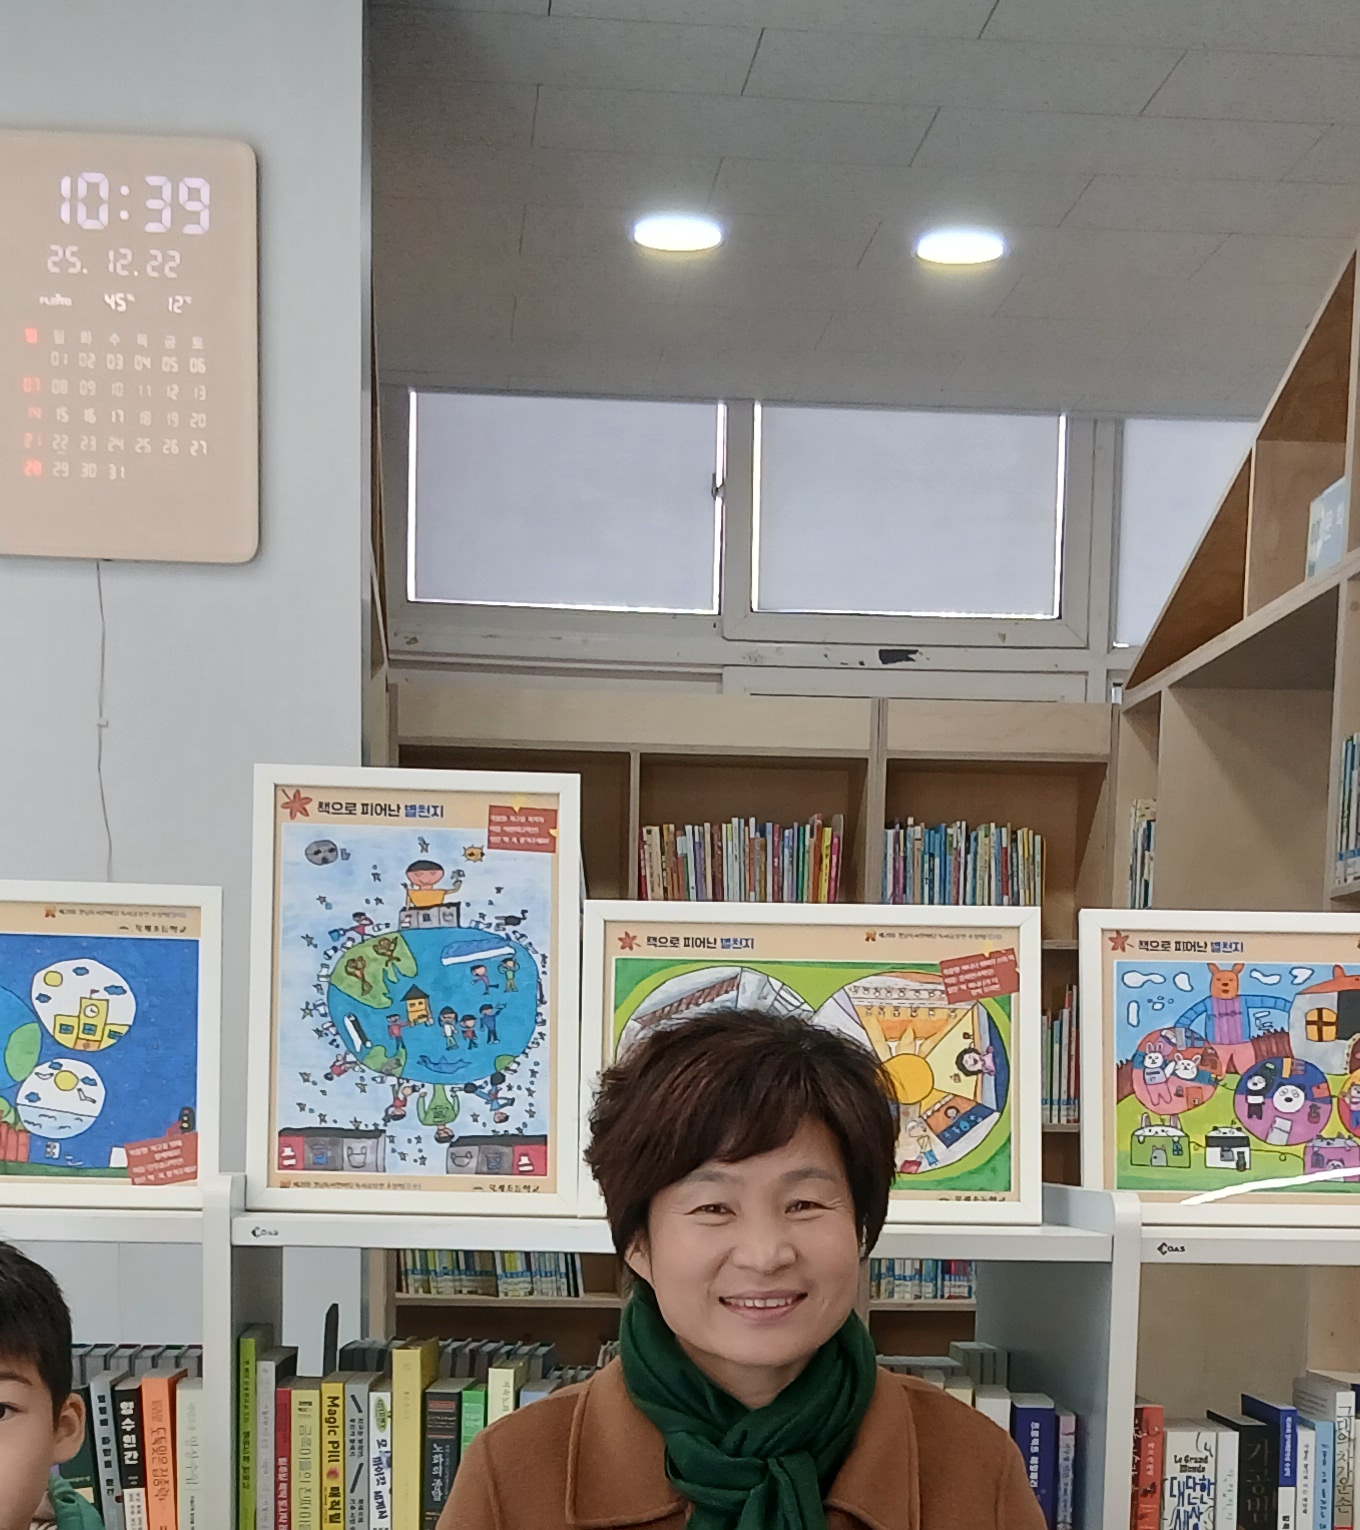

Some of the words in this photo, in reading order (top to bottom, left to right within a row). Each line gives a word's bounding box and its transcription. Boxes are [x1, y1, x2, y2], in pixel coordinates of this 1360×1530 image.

[58, 172, 210, 234] 10:39
[51, 351, 68, 366] 01
[79, 352, 96, 369] 02
[106, 353, 124, 370] 03
[134, 354, 151, 371] 04
[161, 356, 178, 373] 05
[189, 357, 206, 374] 06
[51, 378, 68, 395] 08
[79, 380, 96, 396] 09
[111, 382, 124, 397] 10
[139, 384, 151, 397] 11
[166, 384, 179, 400] 12
[194, 385, 206, 400] 13
[56, 406, 69, 423] 15
[84, 408, 96, 424] 16
[111, 409, 124, 424] 17
[167, 411, 179, 427] 19
[190, 413, 206, 428] 20
[53, 434, 69, 450] 22
[80, 435, 97, 451] 23
[108, 437, 124, 452] 24
[135, 438, 151, 453] 25
[163, 439, 179, 455] 26
[190, 440, 207, 456] 27
[53, 461, 69, 477] 29
[82, 463, 97, 478] 30
[109, 464, 125, 480] 31
[317, 801, 358, 817] 책으로
[360, 802, 401, 818] 피어난
[404, 803, 444, 819] 별천지
[683, 936, 717, 949] 피어난
[1138, 939, 1172, 953] 책으로
[327, 1396, 340, 1436] Magic
[327, 1440, 340, 1464] Pill
[1173, 1455, 1182, 1464] Le
[328, 1486, 342, 1524] 매직필
